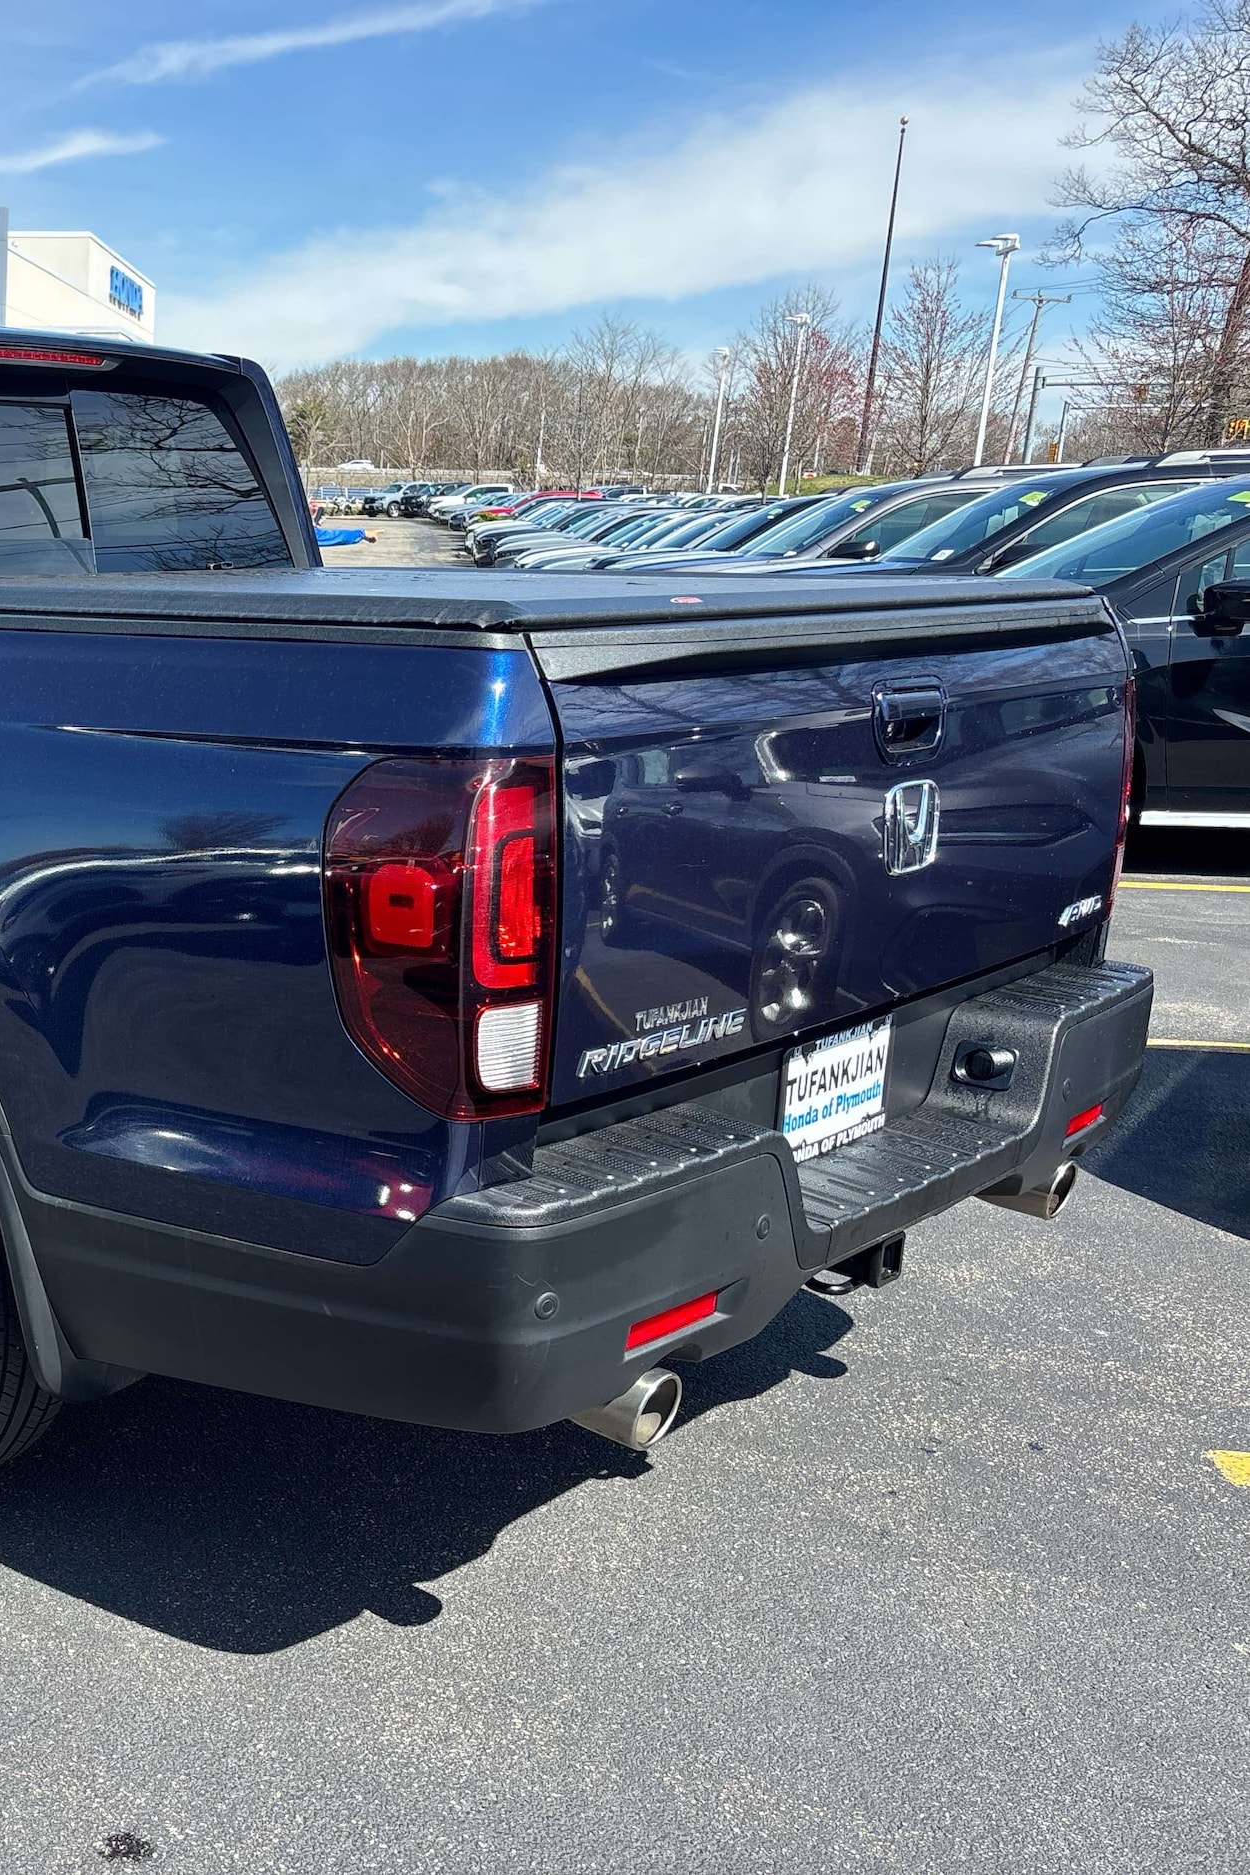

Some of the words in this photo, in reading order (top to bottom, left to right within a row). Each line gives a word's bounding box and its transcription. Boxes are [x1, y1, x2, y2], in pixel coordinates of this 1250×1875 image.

[635, 996, 709, 1031] TUFANKJIAN
[815, 1021, 873, 1050] TUFANKJIAN
[576, 1008, 747, 1078] RIDGELINE
[787, 1044, 886, 1106] TUFANKJIAN
[784, 1105, 818, 1134] Honda
[822, 1098, 834, 1119] of
[836, 1079, 881, 1115] Plymouth
[821, 1136, 836, 1153] OF
[836, 1113, 886, 1147] PLYMOUTH
